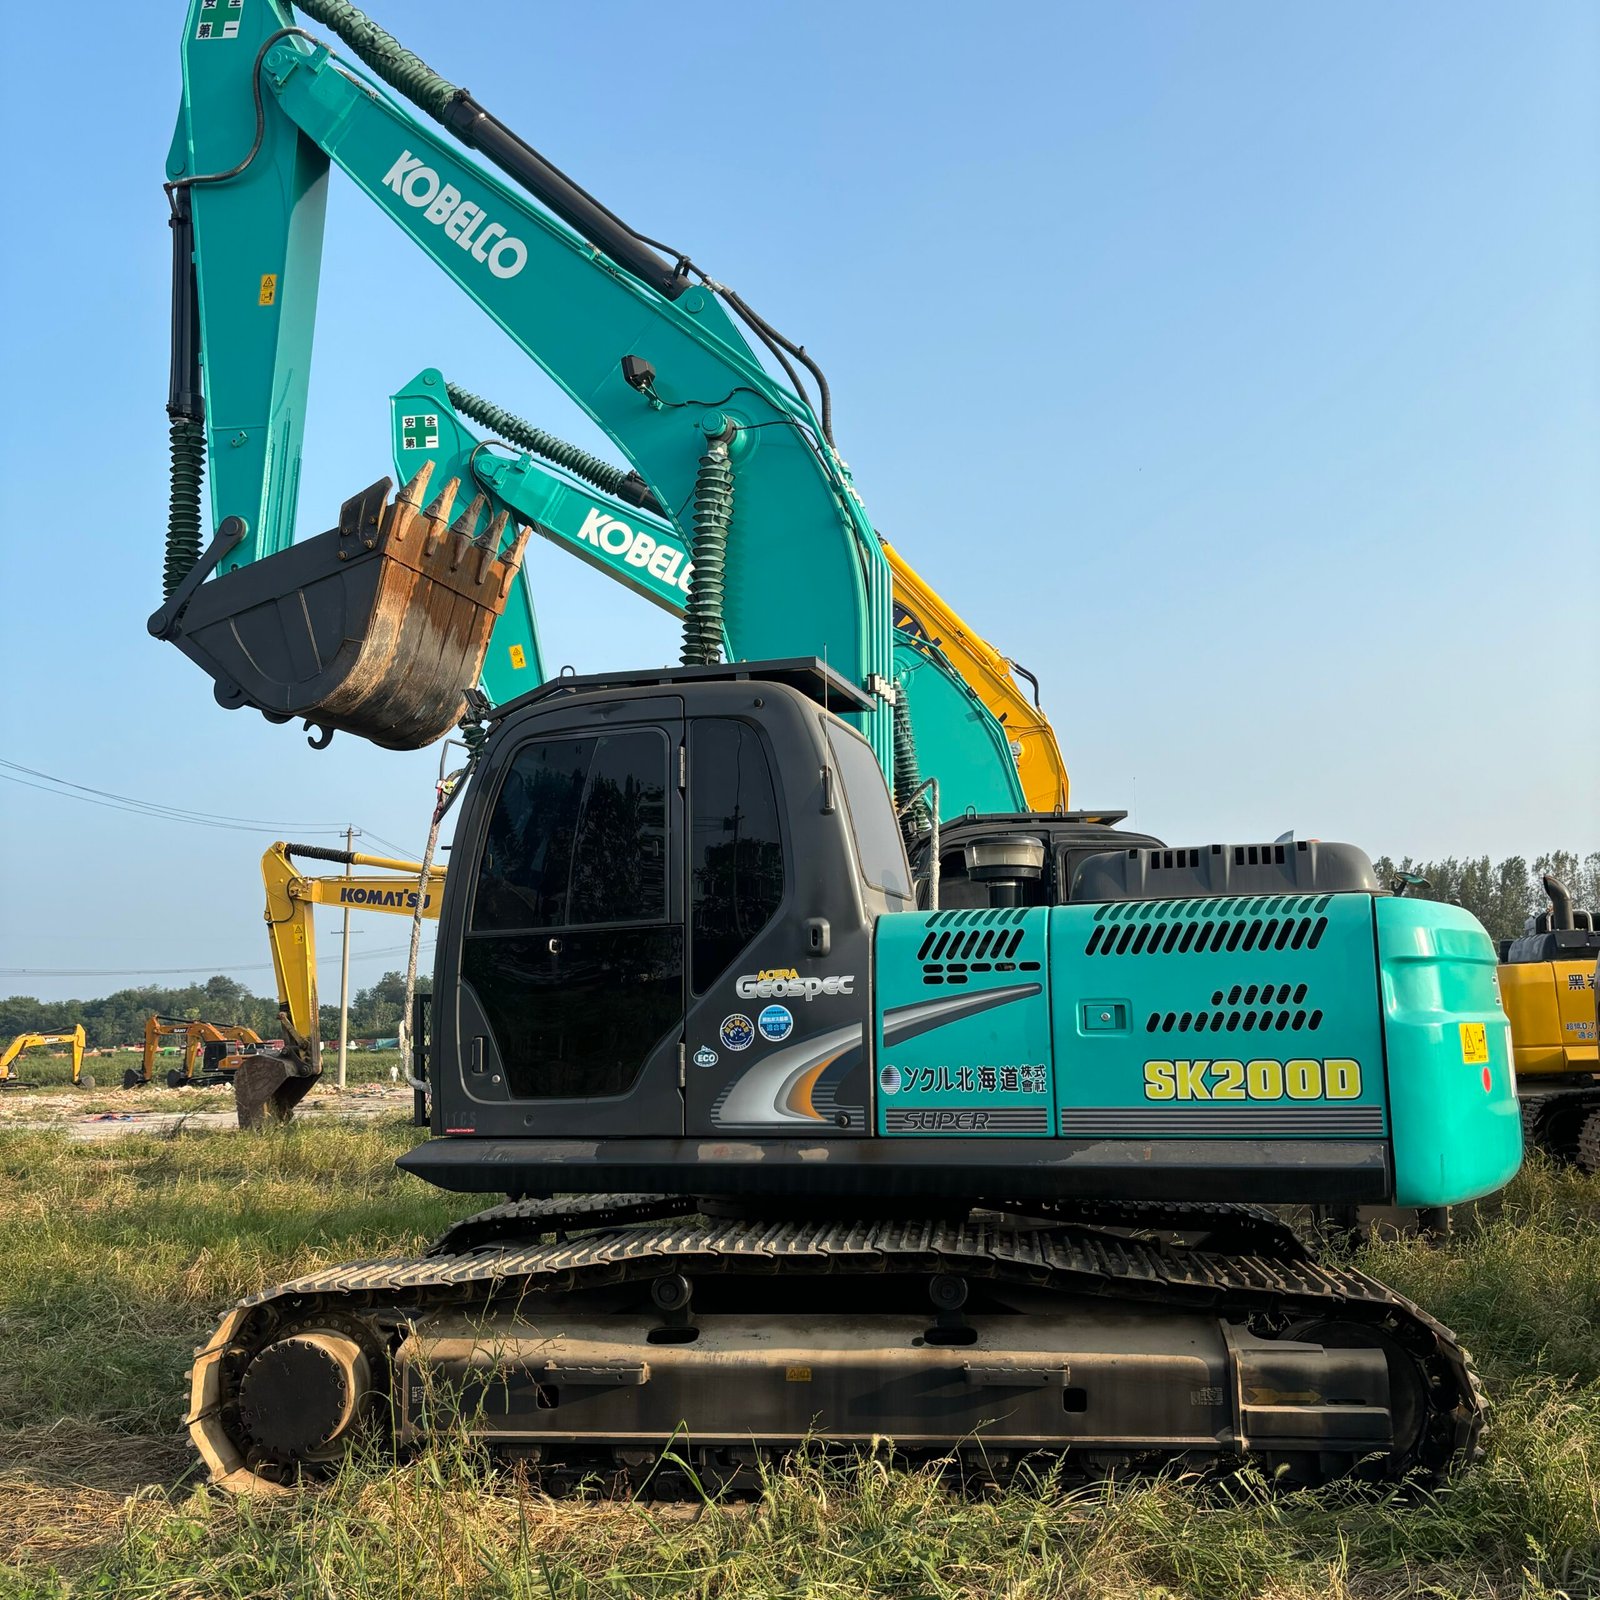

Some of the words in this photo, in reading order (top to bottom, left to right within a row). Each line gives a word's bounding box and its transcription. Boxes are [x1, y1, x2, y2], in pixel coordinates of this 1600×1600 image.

[198, 23, 238, 39] 第一
[381, 149, 528, 279] KOBELCO
[404, 416, 436, 428] 安全
[405, 437, 437, 449] 第一
[757, 968, 800, 981] ACERA
[697, 1054, 716, 1063] ECO
[1143, 1058, 1363, 1101] SK200D
[902, 1111, 991, 1131] SUPER
